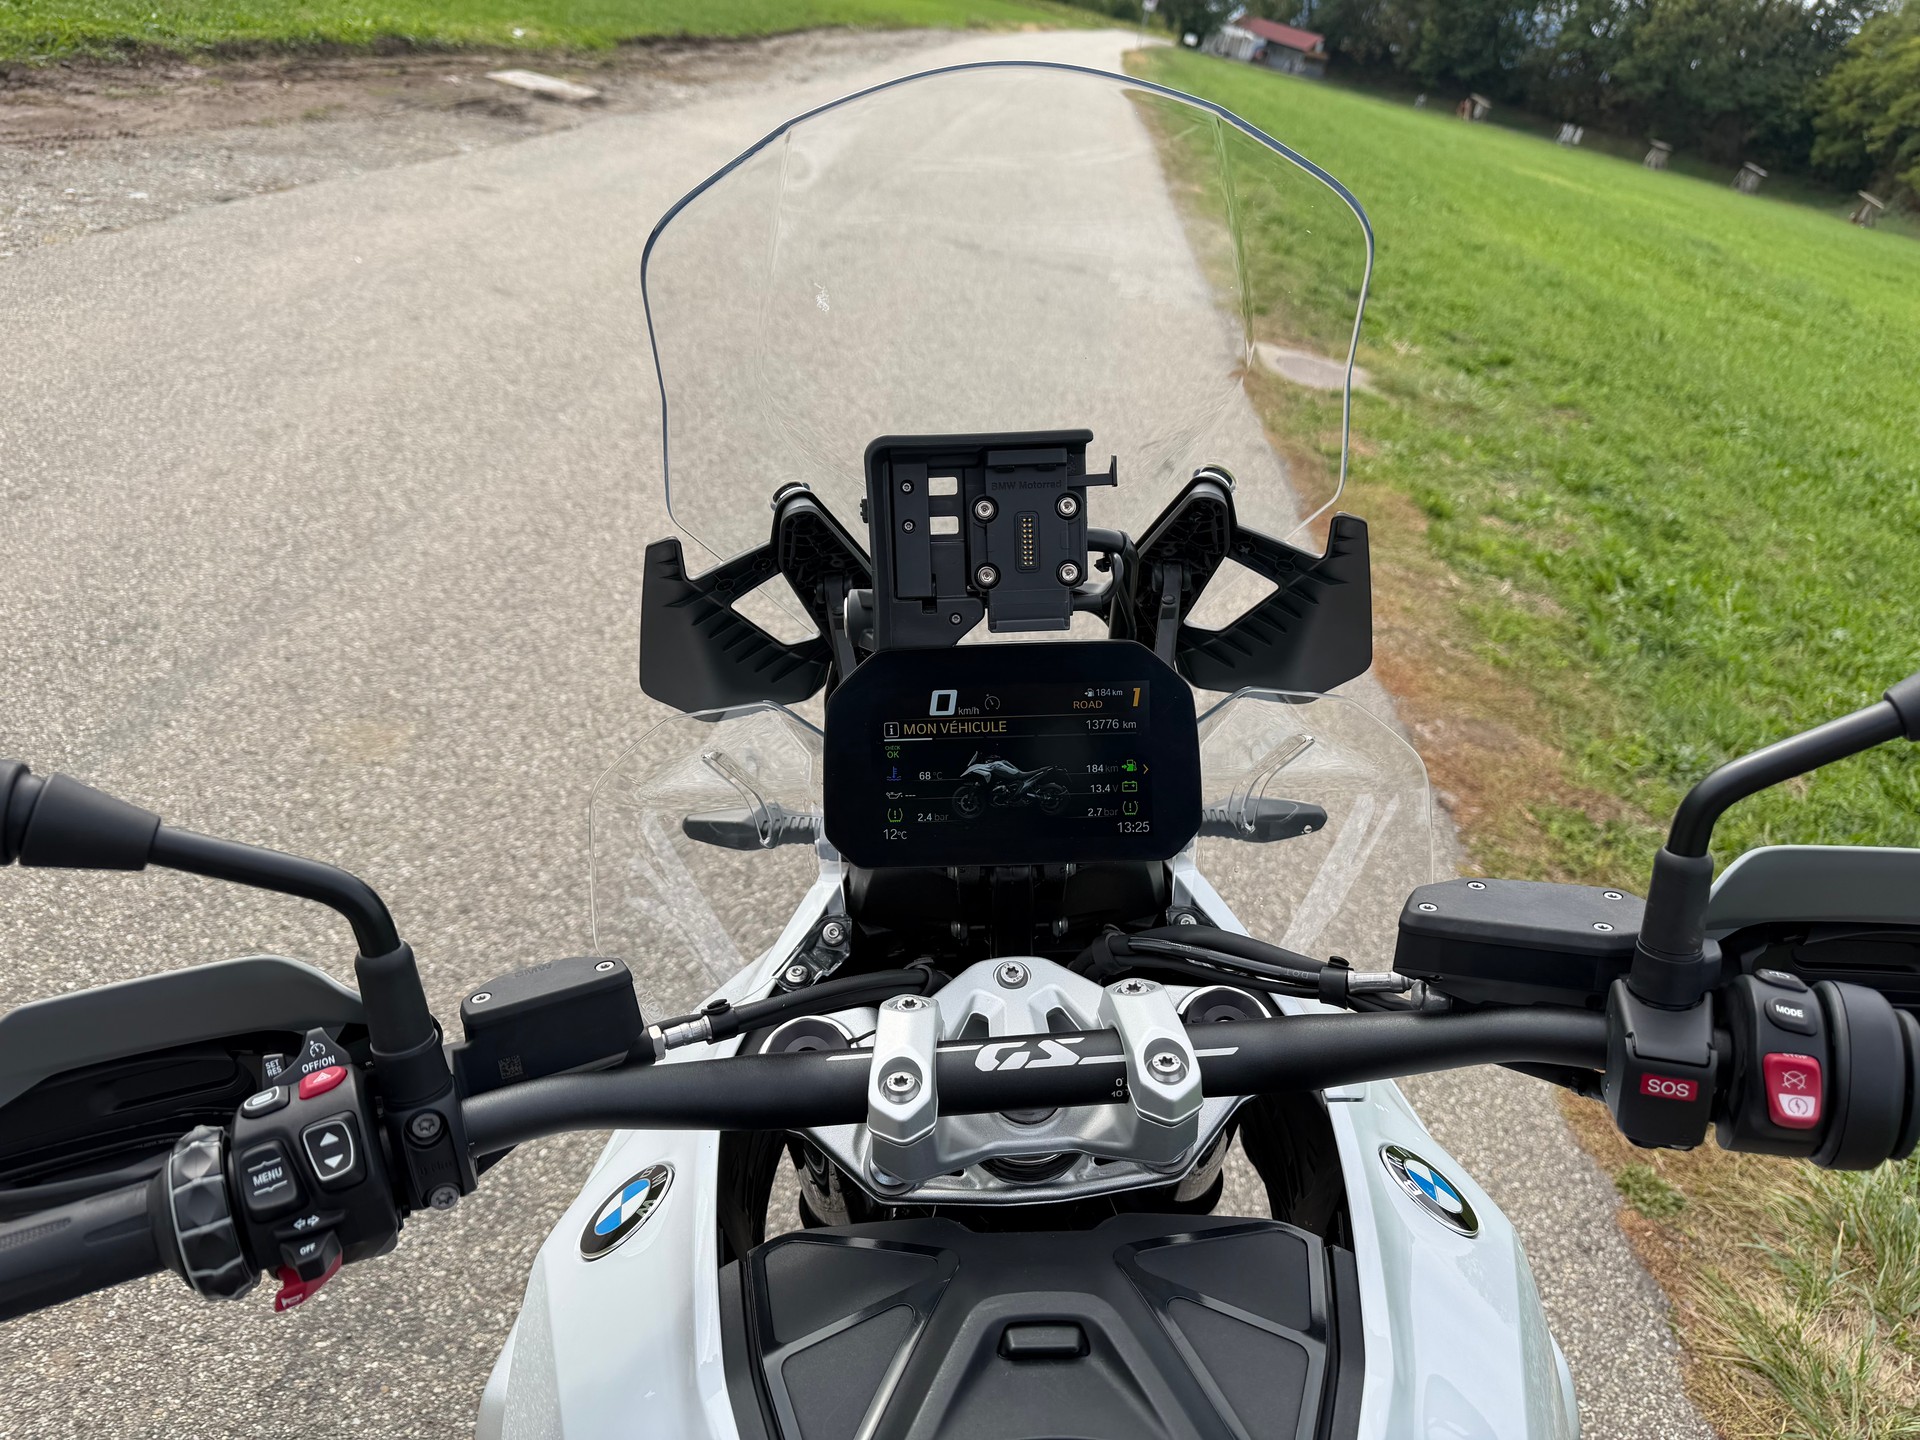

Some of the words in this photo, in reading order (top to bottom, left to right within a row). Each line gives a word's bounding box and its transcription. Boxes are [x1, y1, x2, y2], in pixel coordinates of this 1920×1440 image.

[991, 481, 1016, 491] BMW
[1018, 480, 1062, 489] Motorrad
[1096, 688, 1111, 697] 184
[1132, 687, 1141, 707] 1
[929, 689, 958, 716] 0
[958, 707, 980, 715] km/h
[1073, 700, 1103, 709] ROAD
[903, 723, 937, 735] MON
[940, 720, 1008, 734] VÉHICULE
[1085, 718, 1120, 730] 13776
[1122, 720, 1137, 729] km
[886, 750, 900, 759] OK
[1086, 764, 1104, 773] 184
[1105, 764, 1119, 773] km
[919, 771, 932, 781] 68
[1090, 783, 1111, 793] 13.4
[1112, 784, 1119, 793] V
[917, 813, 933, 822] 2.4
[934, 813, 949, 821] bar
[1087, 807, 1103, 817] 2.7
[1103, 808, 1119, 816] bar
[1117, 820, 1150, 833] 13:25
[1775, 1004, 1804, 1018] MODE
[975, 1037, 1085, 1072] GS
[265, 1059, 280, 1071] SET
[301, 1055, 336, 1074] OFF/ON
[267, 1065, 283, 1077] RES
[1647, 1078, 1690, 1097] SOS
[253, 1166, 283, 1188] MENU
[299, 1242, 316, 1256] OFF
